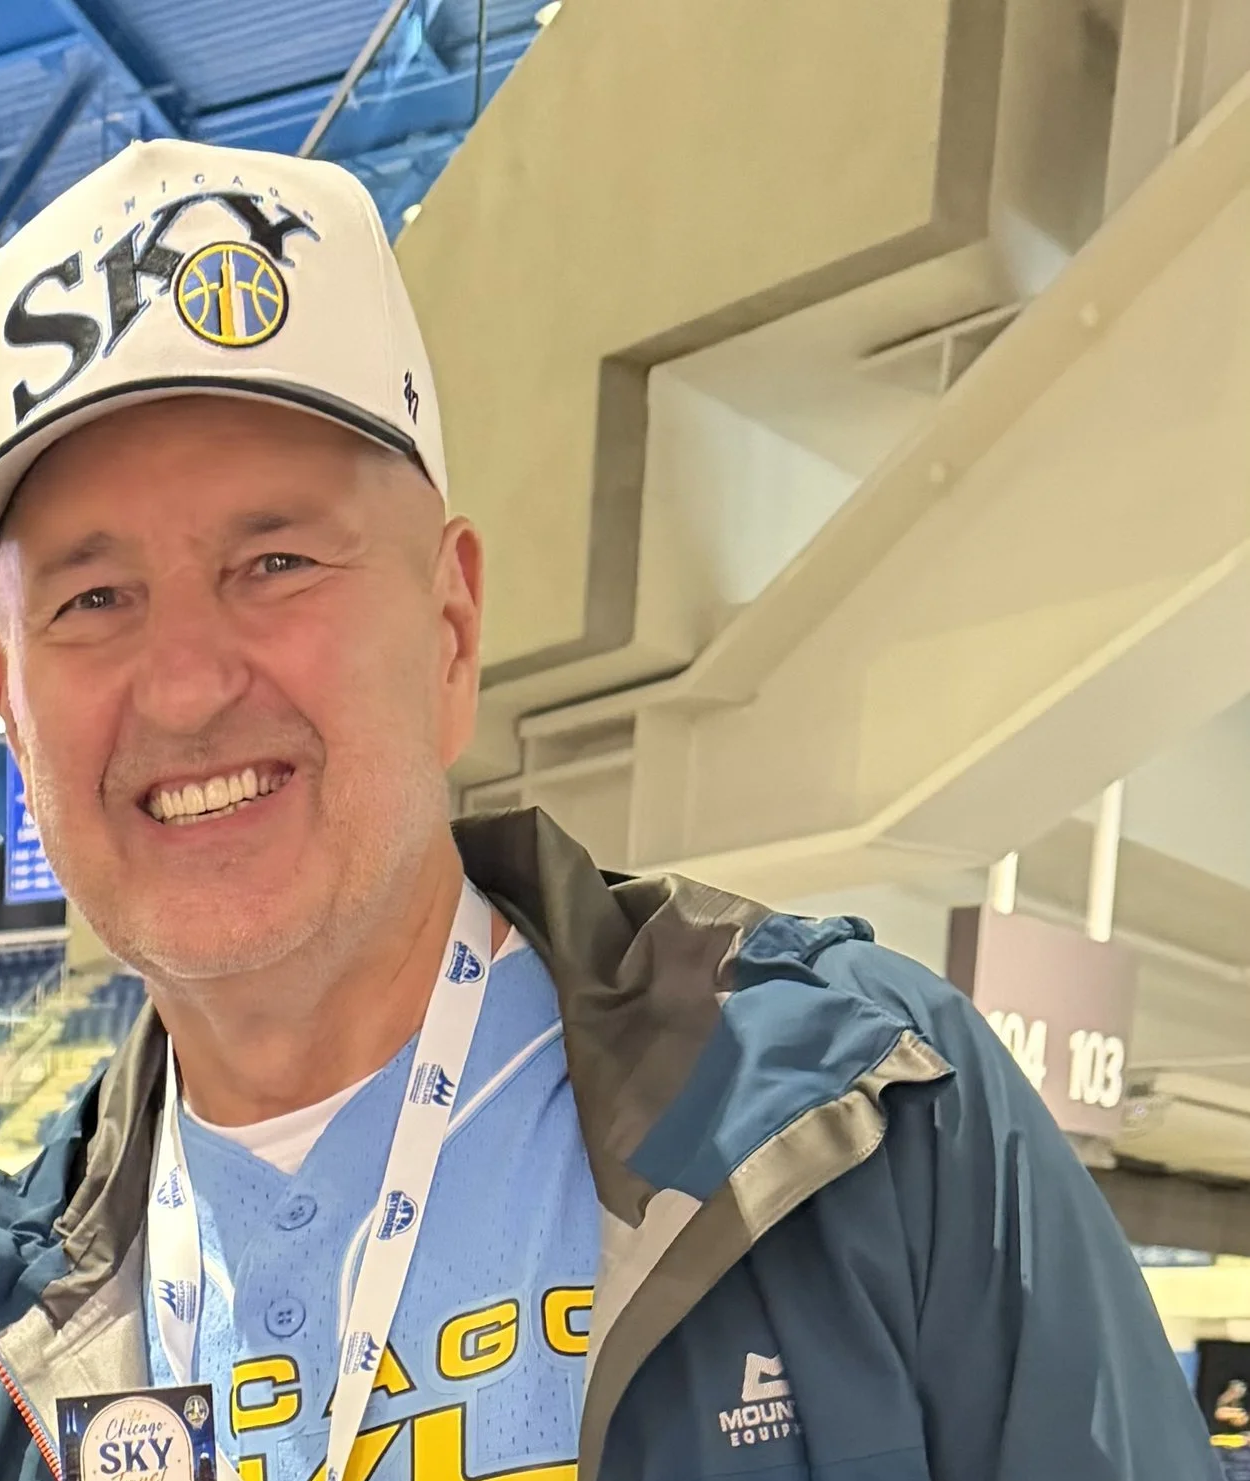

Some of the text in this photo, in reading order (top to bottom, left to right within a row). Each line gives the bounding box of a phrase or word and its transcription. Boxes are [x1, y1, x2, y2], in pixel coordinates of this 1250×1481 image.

[94, 174, 314, 244] CHICAGO
[3, 191, 321, 428] SKY
[1069, 1029, 1124, 1108] 103
[100, 1436, 173, 1474] SKY
[105, 1418, 164, 1440] Chicago
